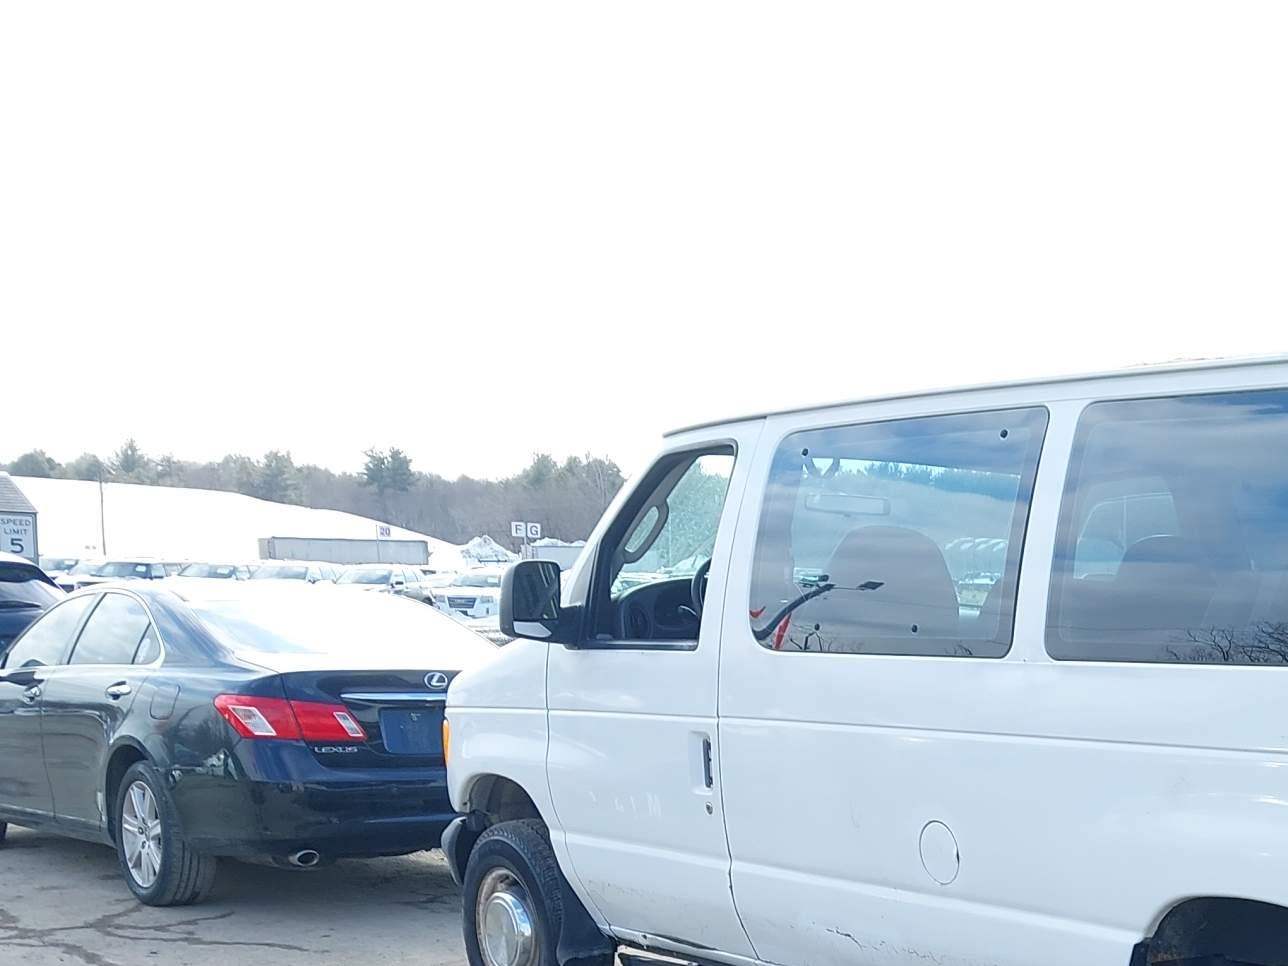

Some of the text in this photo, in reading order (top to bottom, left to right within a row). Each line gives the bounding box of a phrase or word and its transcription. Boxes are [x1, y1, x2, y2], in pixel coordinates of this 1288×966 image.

[0, 518, 31, 526] SPEED
[3, 527, 27, 535] LIMIT
[529, 525, 539, 536] G
[10, 538, 24, 554] 5
